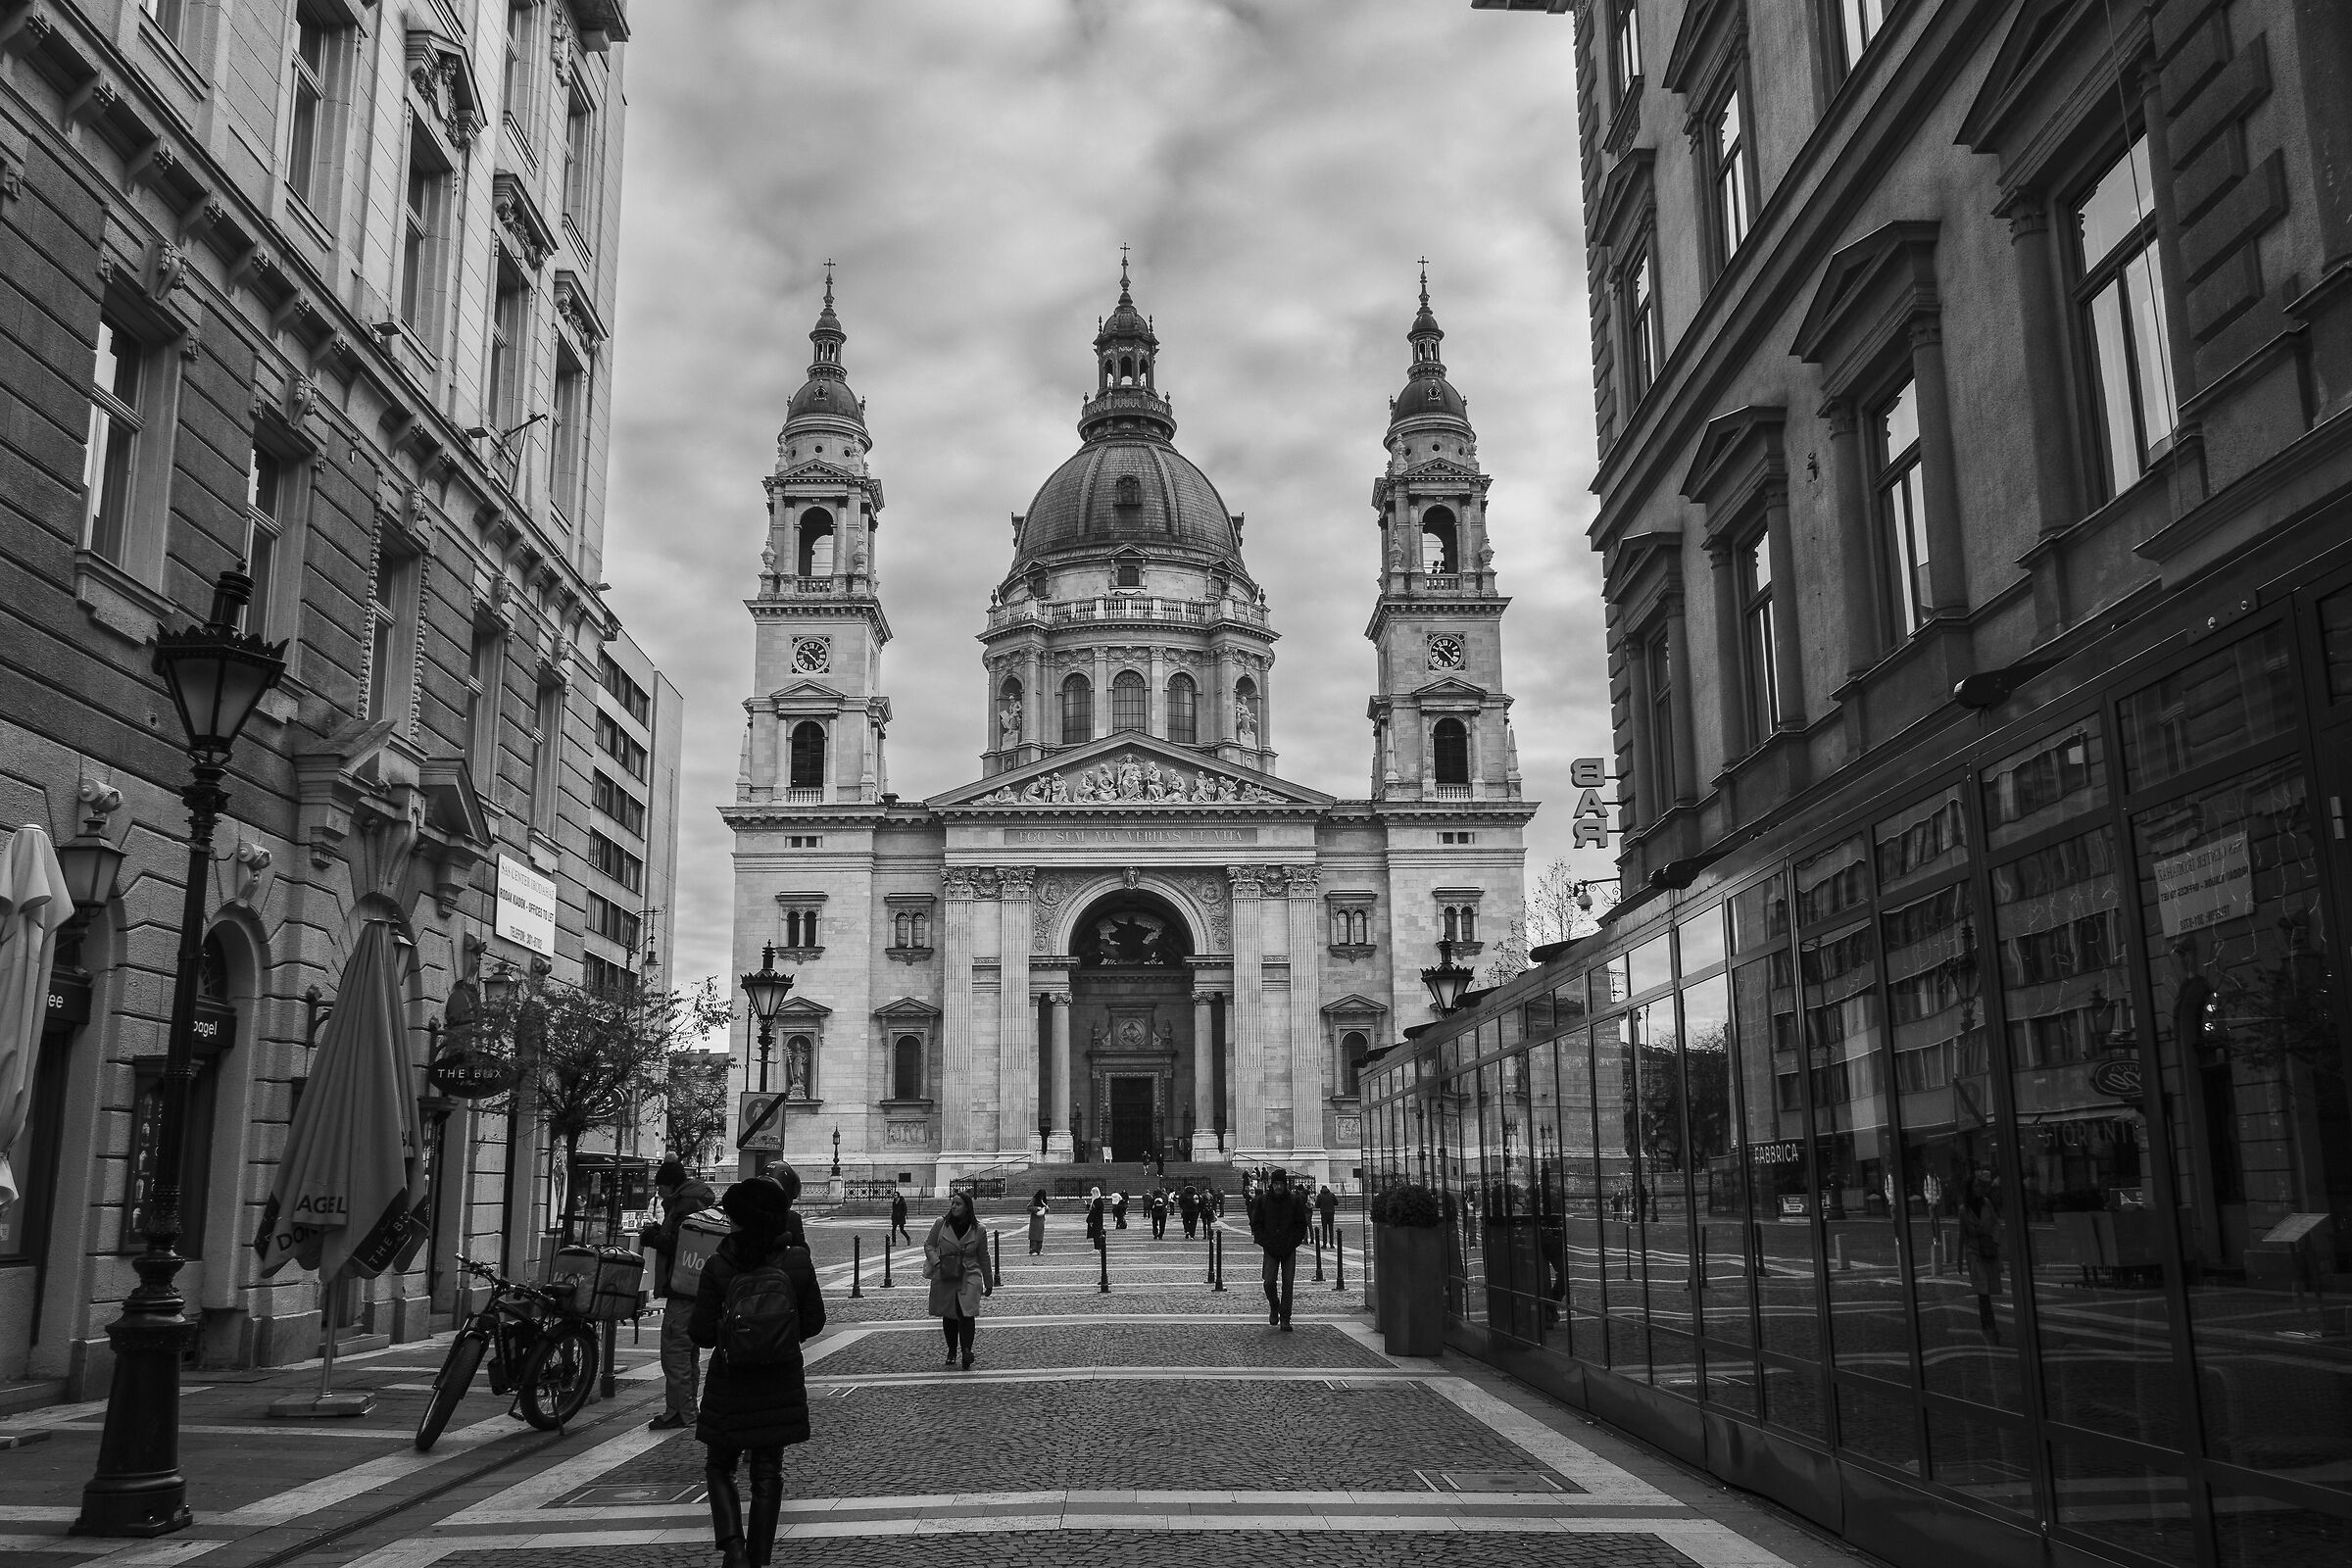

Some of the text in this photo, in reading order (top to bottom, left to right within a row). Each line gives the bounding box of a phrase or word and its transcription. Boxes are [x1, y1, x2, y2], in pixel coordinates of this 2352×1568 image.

[1018, 830, 1243, 843] EGO SUM VIA VERITAS ET VITA
[512, 868, 530, 887] CENTER
[528, 902, 542, 917] OFFICES
[437, 1068, 466, 1079] THE
[1754, 1143, 1799, 1164] FABBRICA
[296, 1195, 347, 1214] AGEL
[368, 1237, 393, 1264] THE
[393, 1207, 412, 1232] BO
[682, 1250, 711, 1271] Wo
